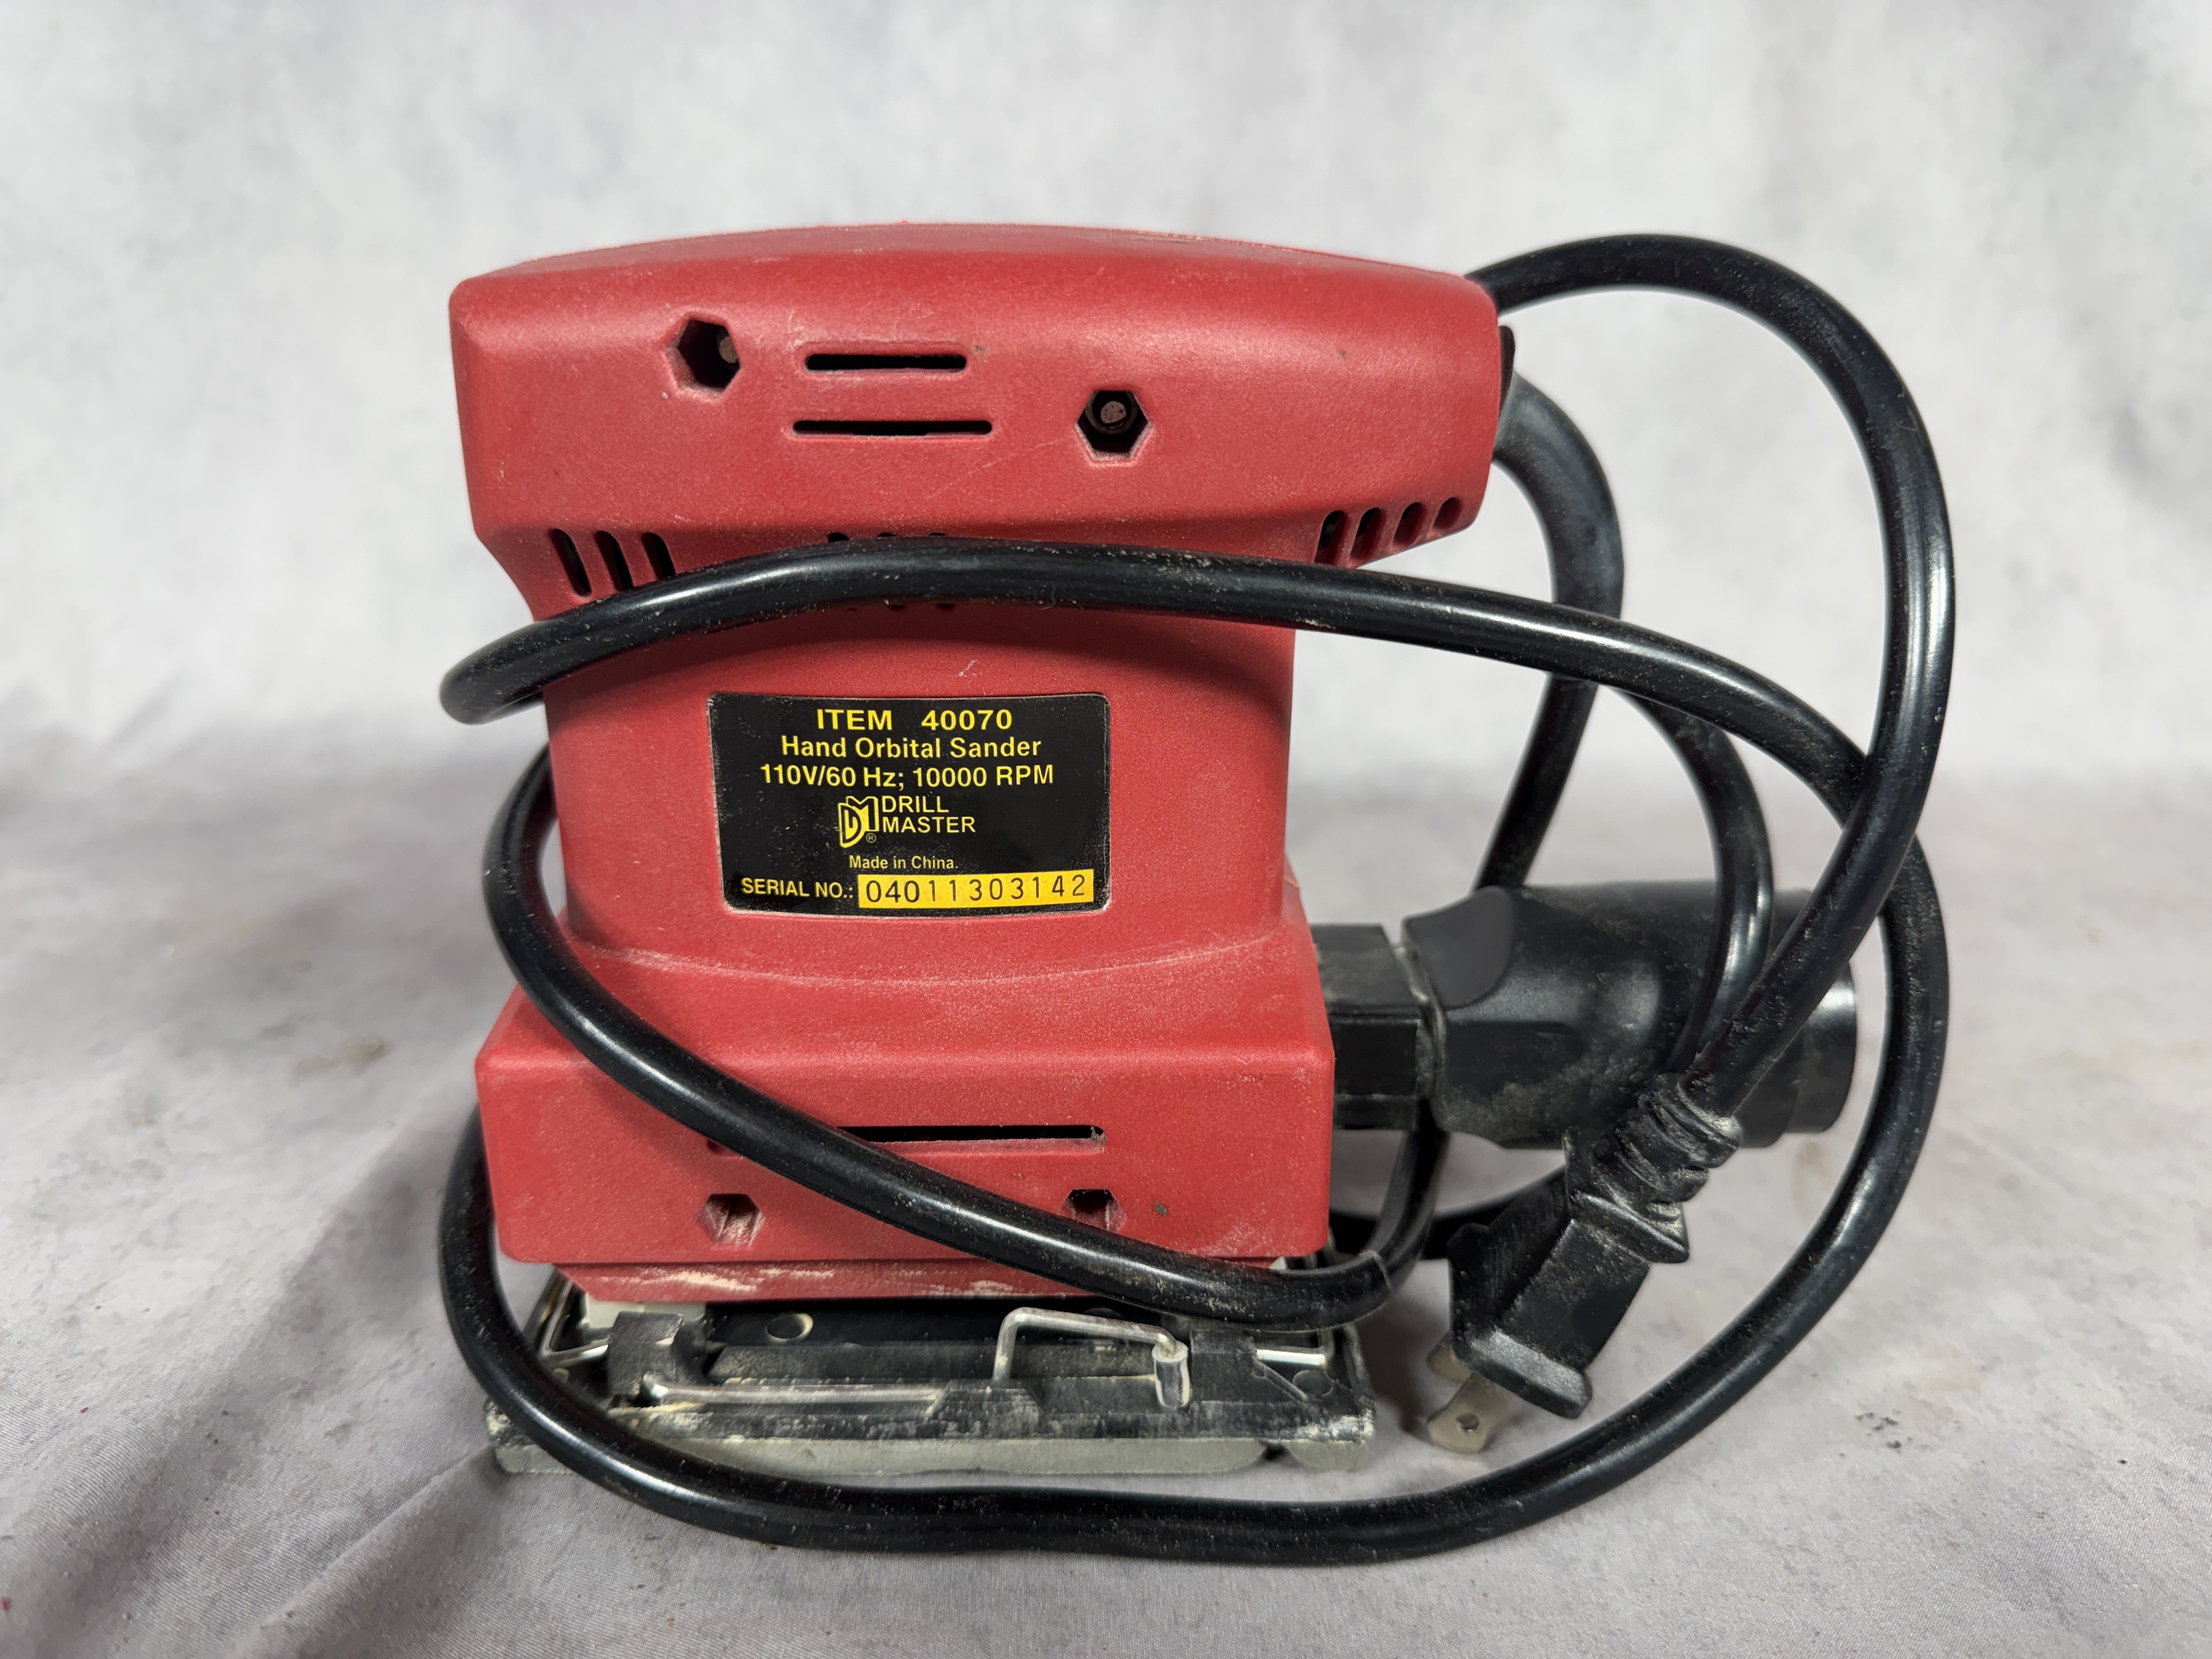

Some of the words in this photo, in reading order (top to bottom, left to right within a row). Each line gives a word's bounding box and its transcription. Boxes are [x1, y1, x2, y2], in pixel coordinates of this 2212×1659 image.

[816, 708, 893, 731] ITEM
[921, 708, 1012, 731] 40070
[781, 735, 847, 758] Hand
[855, 737, 941, 758] Orbital
[950, 736, 1042, 758] Sander
[760, 763, 856, 787] 110V/60
[863, 766, 904, 789] Hz;
[912, 767, 987, 787] 10000
[996, 764, 1053, 786] RPM
[882, 795, 949, 813] DRILL
[882, 816, 976, 833] MASTER
[849, 855, 888, 870] Made
[893, 857, 906, 869] in
[911, 855, 958, 870] China.
[741, 877, 810, 896] SERIAL
[815, 882, 853, 899] NO.:
[866, 873, 1086, 904] 04011303142
